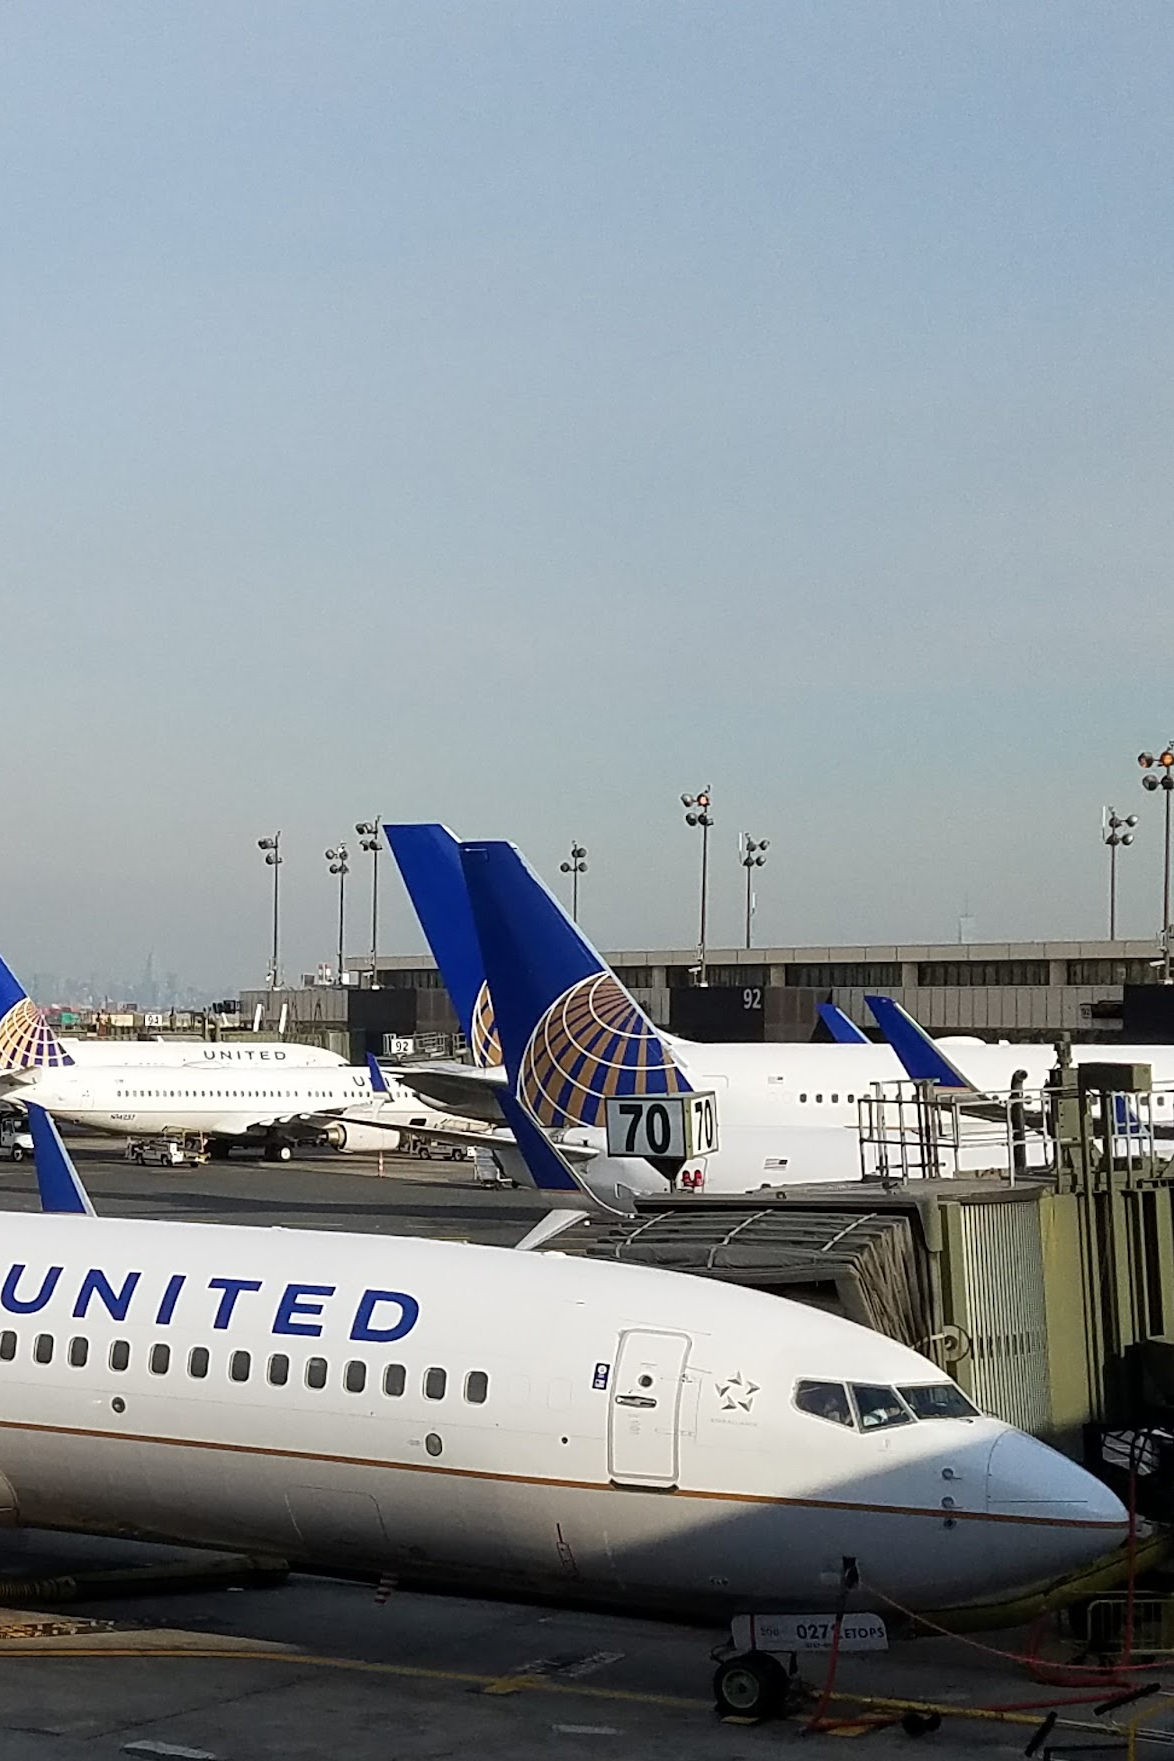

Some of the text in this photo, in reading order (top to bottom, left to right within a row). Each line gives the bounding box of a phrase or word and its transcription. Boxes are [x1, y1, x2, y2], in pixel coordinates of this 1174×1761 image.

[743, 988, 762, 1010] 92
[203, 1050, 286, 1061] UNITED
[395, 1040, 409, 1052] 92
[619, 1103, 671, 1155] 70
[694, 1099, 714, 1151] 70
[0, 1264, 420, 1344] UNITED
[844, 1627, 886, 1639] ETOPS
